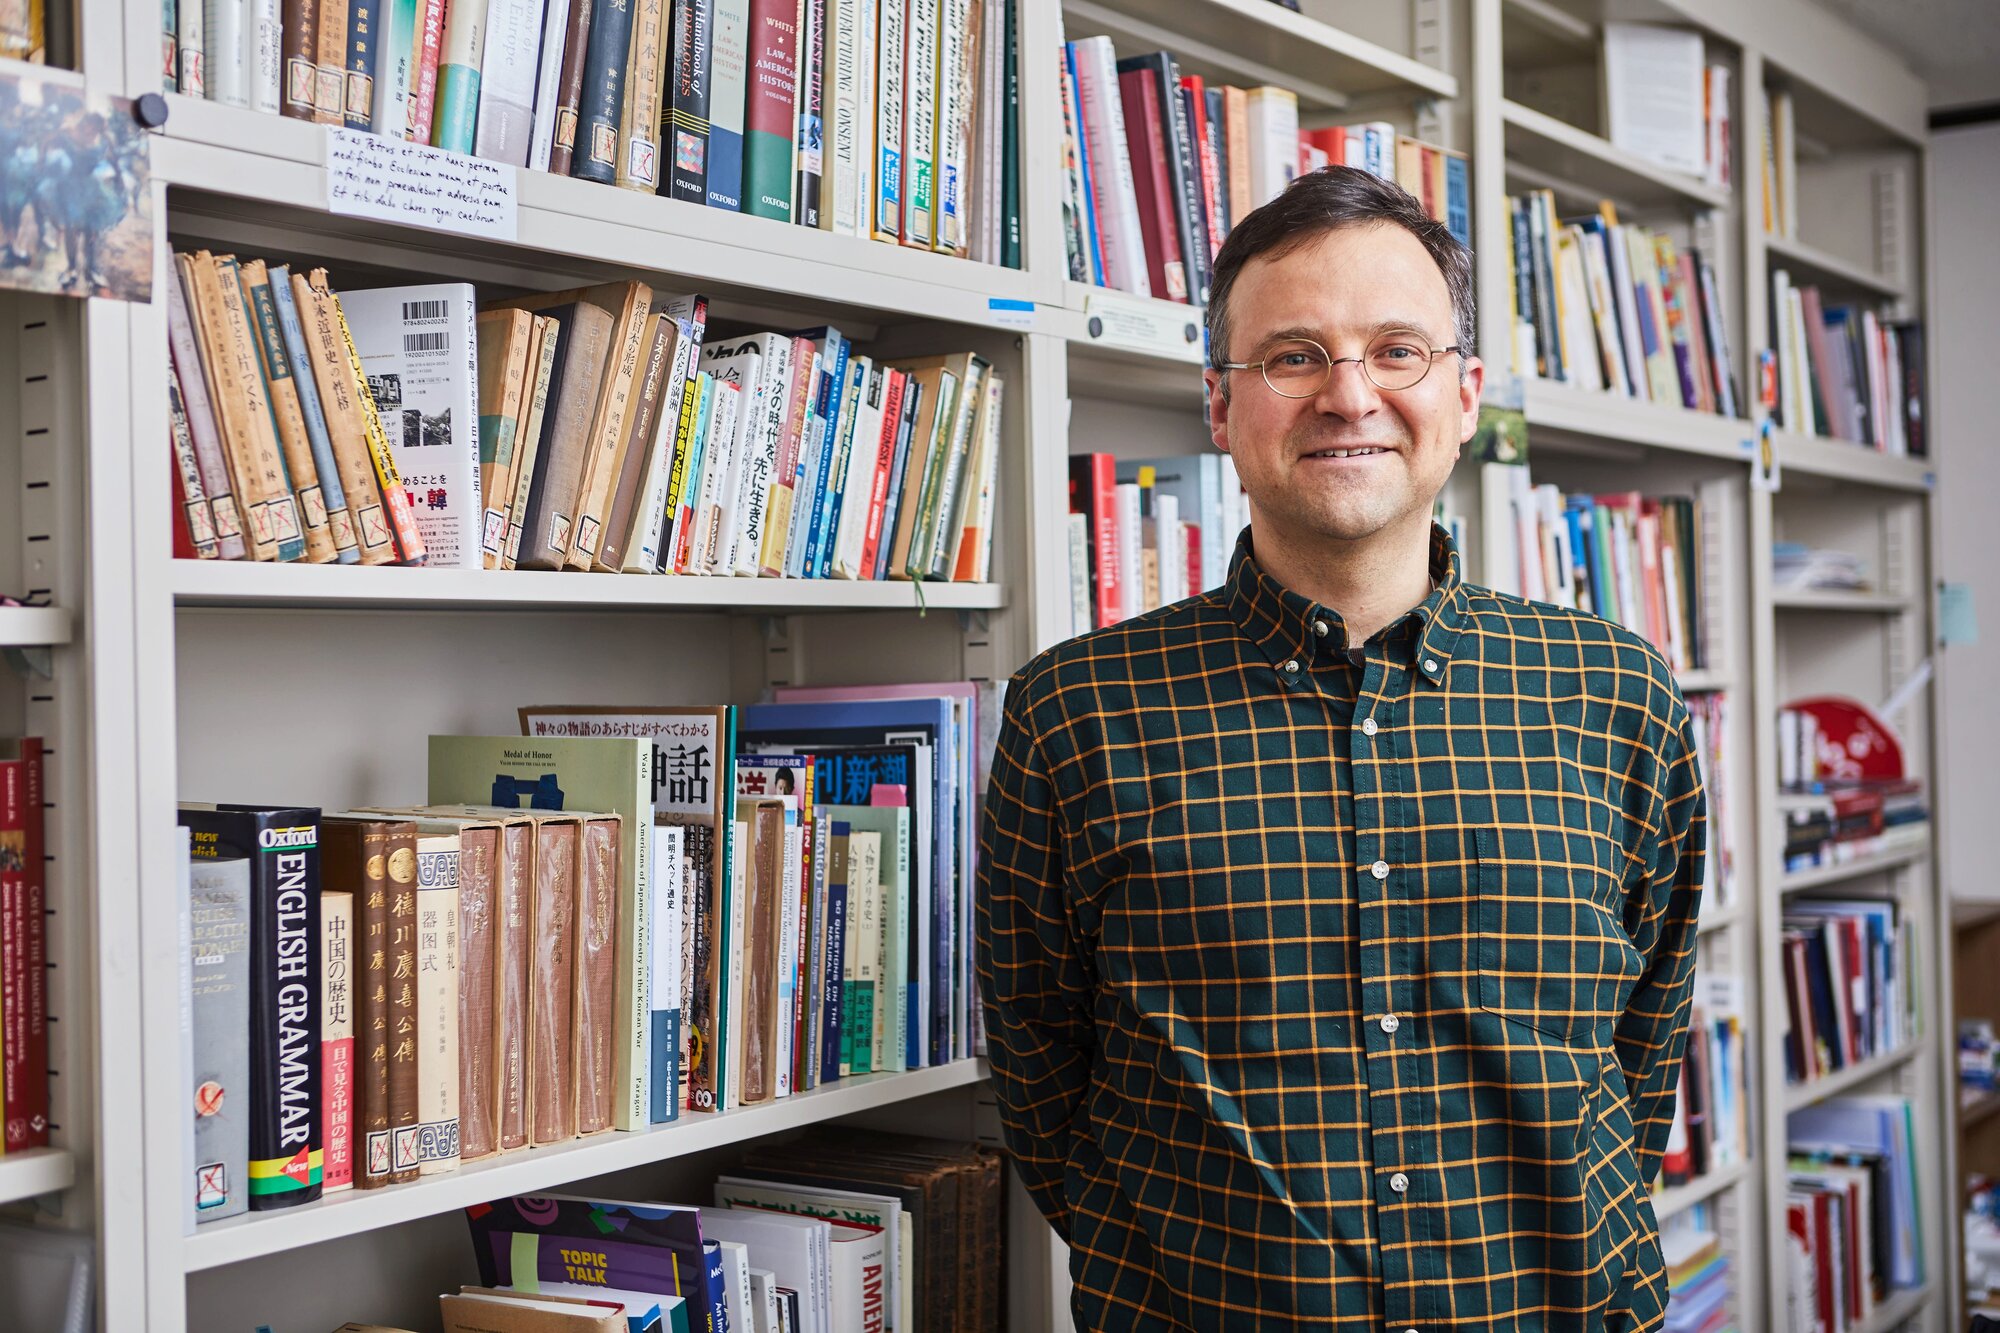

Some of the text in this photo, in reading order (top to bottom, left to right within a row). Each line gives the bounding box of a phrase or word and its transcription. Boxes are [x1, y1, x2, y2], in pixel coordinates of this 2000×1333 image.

[505, 3, 524, 67] Europe
[718, 9, 741, 24] WHITE
[766, 17, 795, 35] WHITE
[681, 6, 694, 97] IDEOLOGIES
[690, 11, 707, 99] Handbook of
[766, 47, 786, 60] LAW
[811, 72, 822, 111] FILM
[913, 26, 926, 153] Phrase Origins
[837, 96, 855, 163] CONSENT
[365, 137, 395, 155] Petrus
[402, 144, 413, 156] et
[445, 152, 464, 168] hanc
[468, 158, 499, 175] petram
[332, 185, 347, 198] Et
[432, 205, 453, 224] regni
[364, 175, 381, 186] non
[447, 188, 480, 204] adversus
[466, 176, 479, 189] et
[480, 179, 508, 196] portae
[676, 178, 702, 194] OXFORD
[709, 191, 738, 207] OXFORD
[762, 195, 789, 210] OXFORD
[620, 300, 648, 378] 近代日本の形成
[836, 345, 846, 372] DAVID
[889, 384, 901, 417] NOAM
[879, 418, 897, 470] CHOMSKY
[835, 446, 851, 493] dependence
[746, 457, 769, 548] 先に生きる。
[535, 722, 710, 737] 神々の物語のあらすじがすべてわかる
[503, 750, 552, 759] Medal of Honor
[195, 832, 218, 843] new
[258, 825, 318, 849] Oxford
[815, 818, 826, 881] KIRAIGO
[639, 866, 645, 875] of
[667, 833, 676, 910] 簡明チベット通史
[862, 843, 875, 921] 人物アメリカ史
[15, 881, 23, 917] HUMAN
[15, 920, 24, 952] ACTION
[421, 910, 438, 973] 器图式
[637, 920, 645, 965] Ancestry
[827, 926, 835, 976] NATURAL
[832, 919, 841, 981] QUESTIONS
[4, 944, 13, 983] SCOTUS
[328, 915, 347, 1025] 中国の歴史
[16, 974, 25, 1014] THOMAS
[32, 966, 41, 1035] IMMORTALS
[275, 852, 312, 1149] ENGLISH GRAMMAR
[831, 986, 838, 1003] ON
[829, 1007, 837, 1029] THE
[330, 1046, 349, 1164] 目で見る中国の歴史
[634, 1077, 642, 1117] Paragon
[286, 1161, 309, 1174] New
[560, 1248, 608, 1268] TOPIC
[565, 1265, 607, 1286] TALK
[715, 1302, 723, 1318] An
